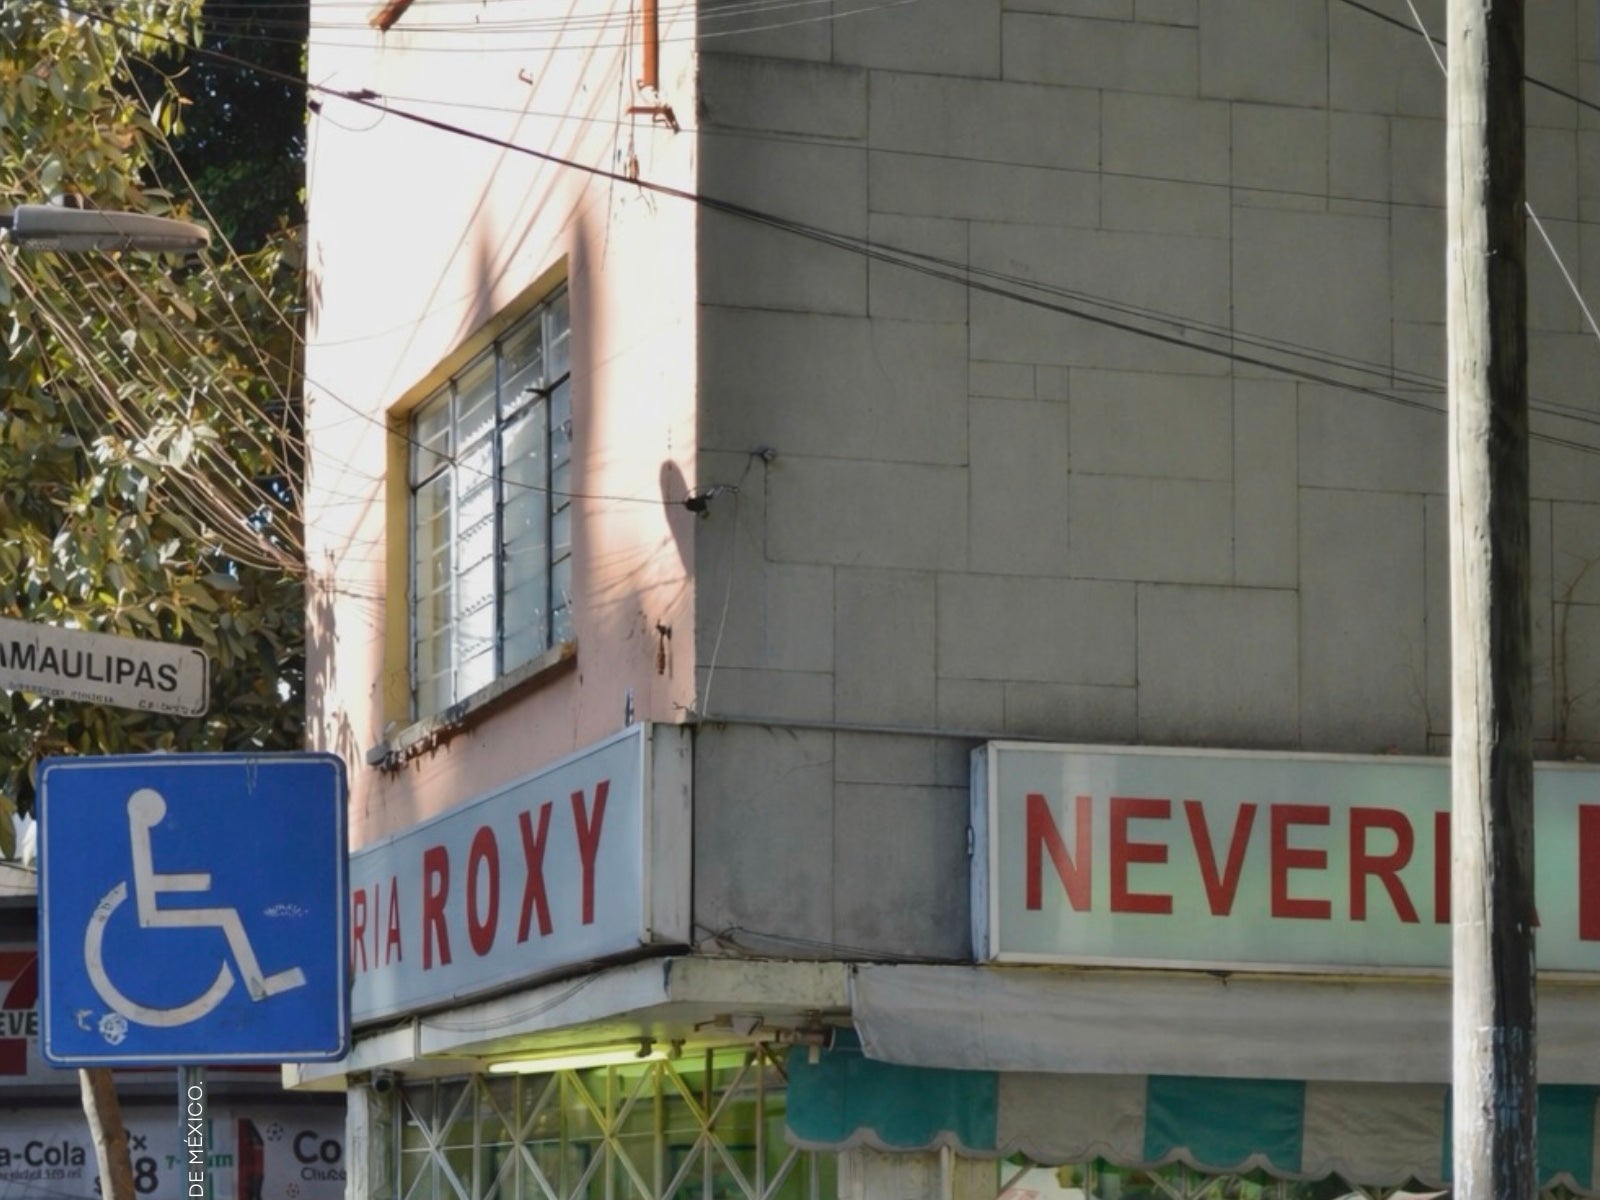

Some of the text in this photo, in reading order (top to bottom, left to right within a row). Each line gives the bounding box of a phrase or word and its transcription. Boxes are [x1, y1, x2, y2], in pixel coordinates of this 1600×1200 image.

[423, 780, 611, 971] ROXY
[1027, 794, 1540, 927] NEVERI
[293, 1130, 344, 1165] Co
